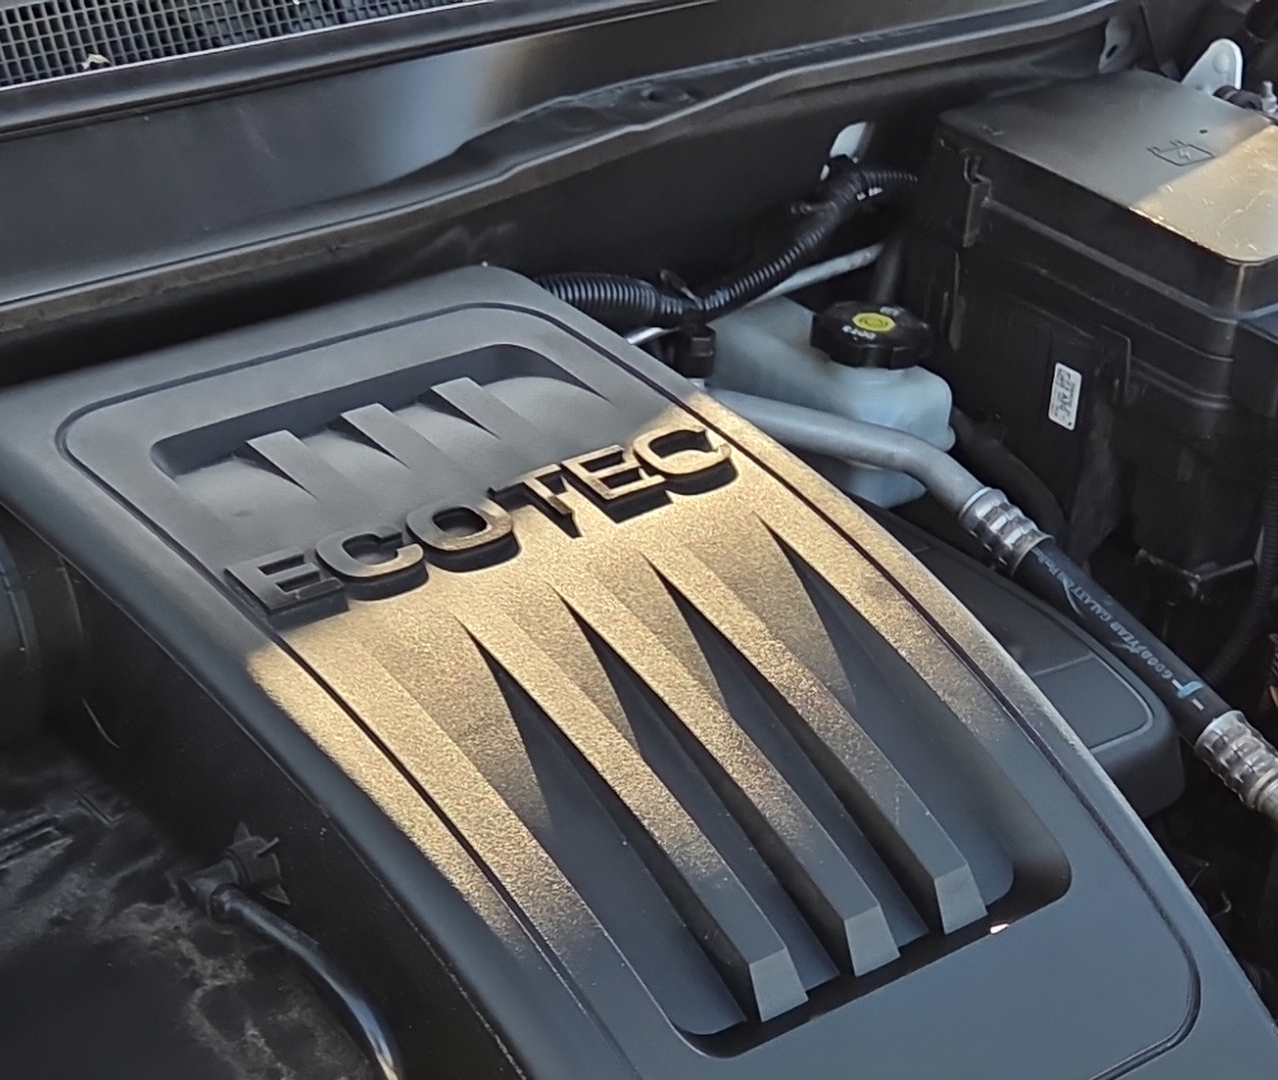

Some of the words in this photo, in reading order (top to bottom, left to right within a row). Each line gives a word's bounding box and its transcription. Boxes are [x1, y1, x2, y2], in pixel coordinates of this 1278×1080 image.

[224, 427, 737, 614] ECOTEC
[1069, 584, 1112, 623] GALAXY
[1109, 619, 1173, 681] GOODYEAR
